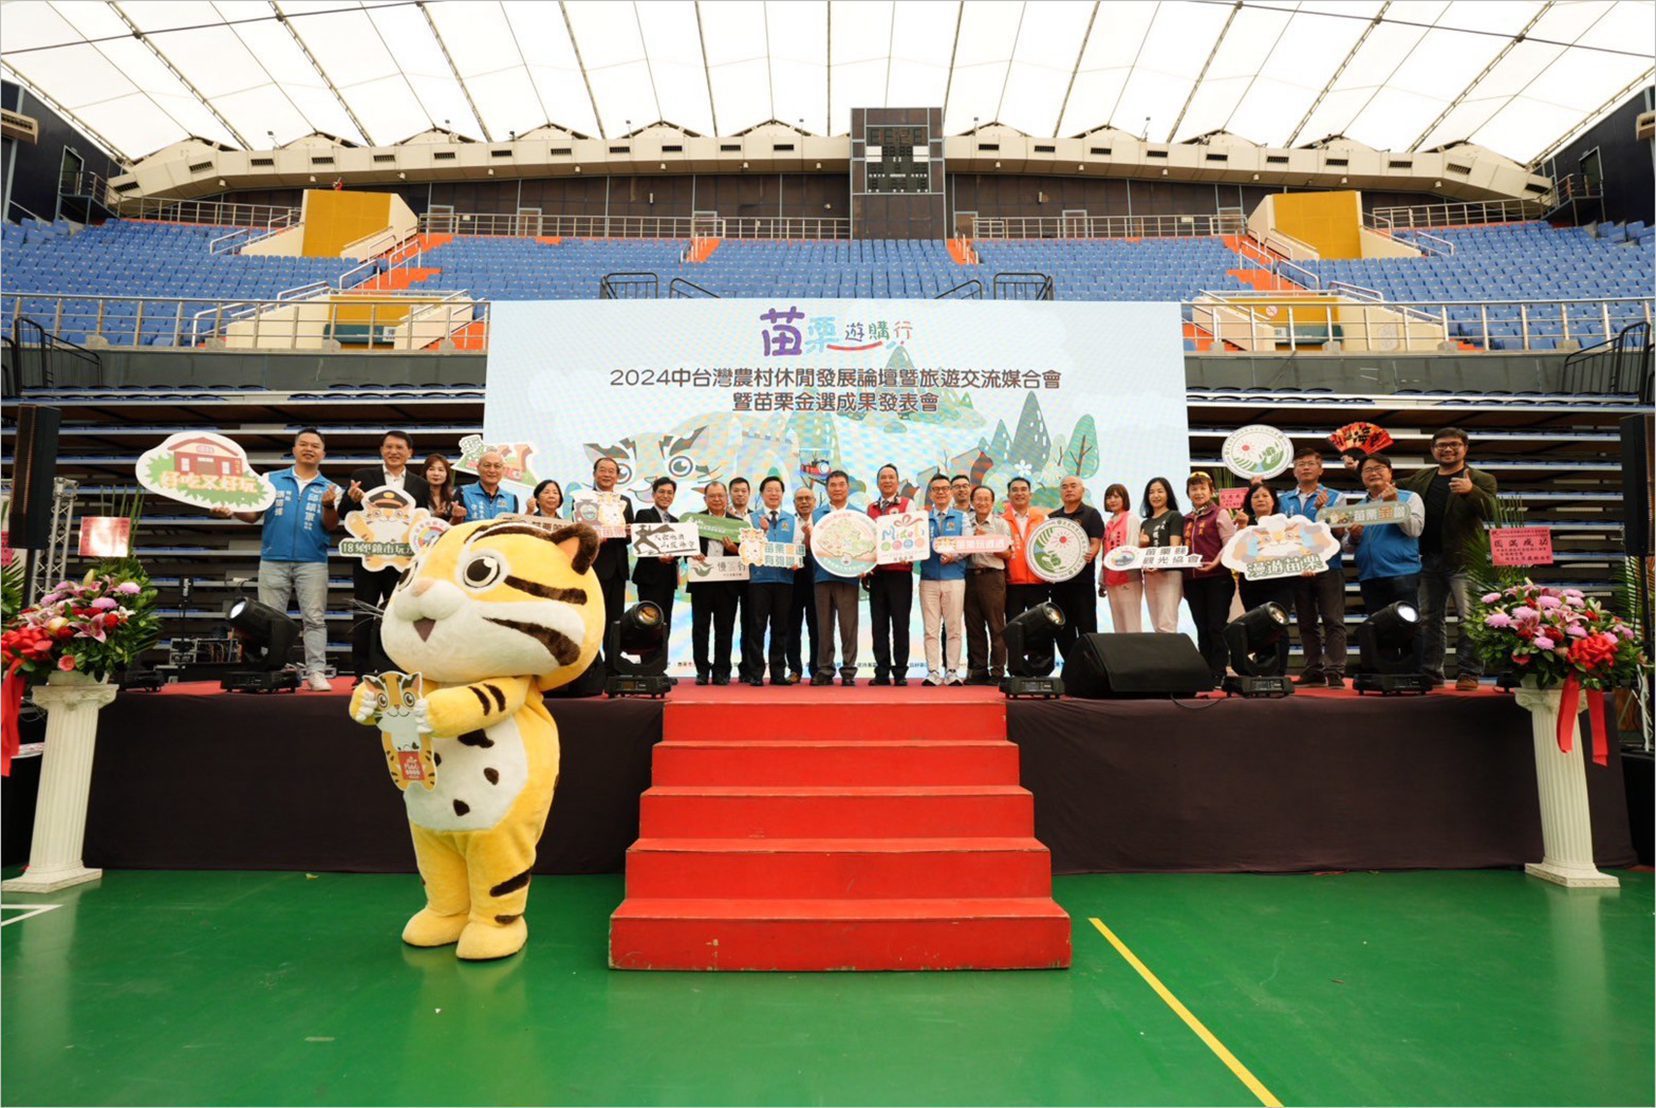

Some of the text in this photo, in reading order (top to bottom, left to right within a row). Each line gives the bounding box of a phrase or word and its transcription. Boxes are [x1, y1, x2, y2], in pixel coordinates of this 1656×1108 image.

[733, 391, 939, 412] 暨苗栗金選成果發表會
[1247, 555, 1322, 577] 漫遊苗栗
